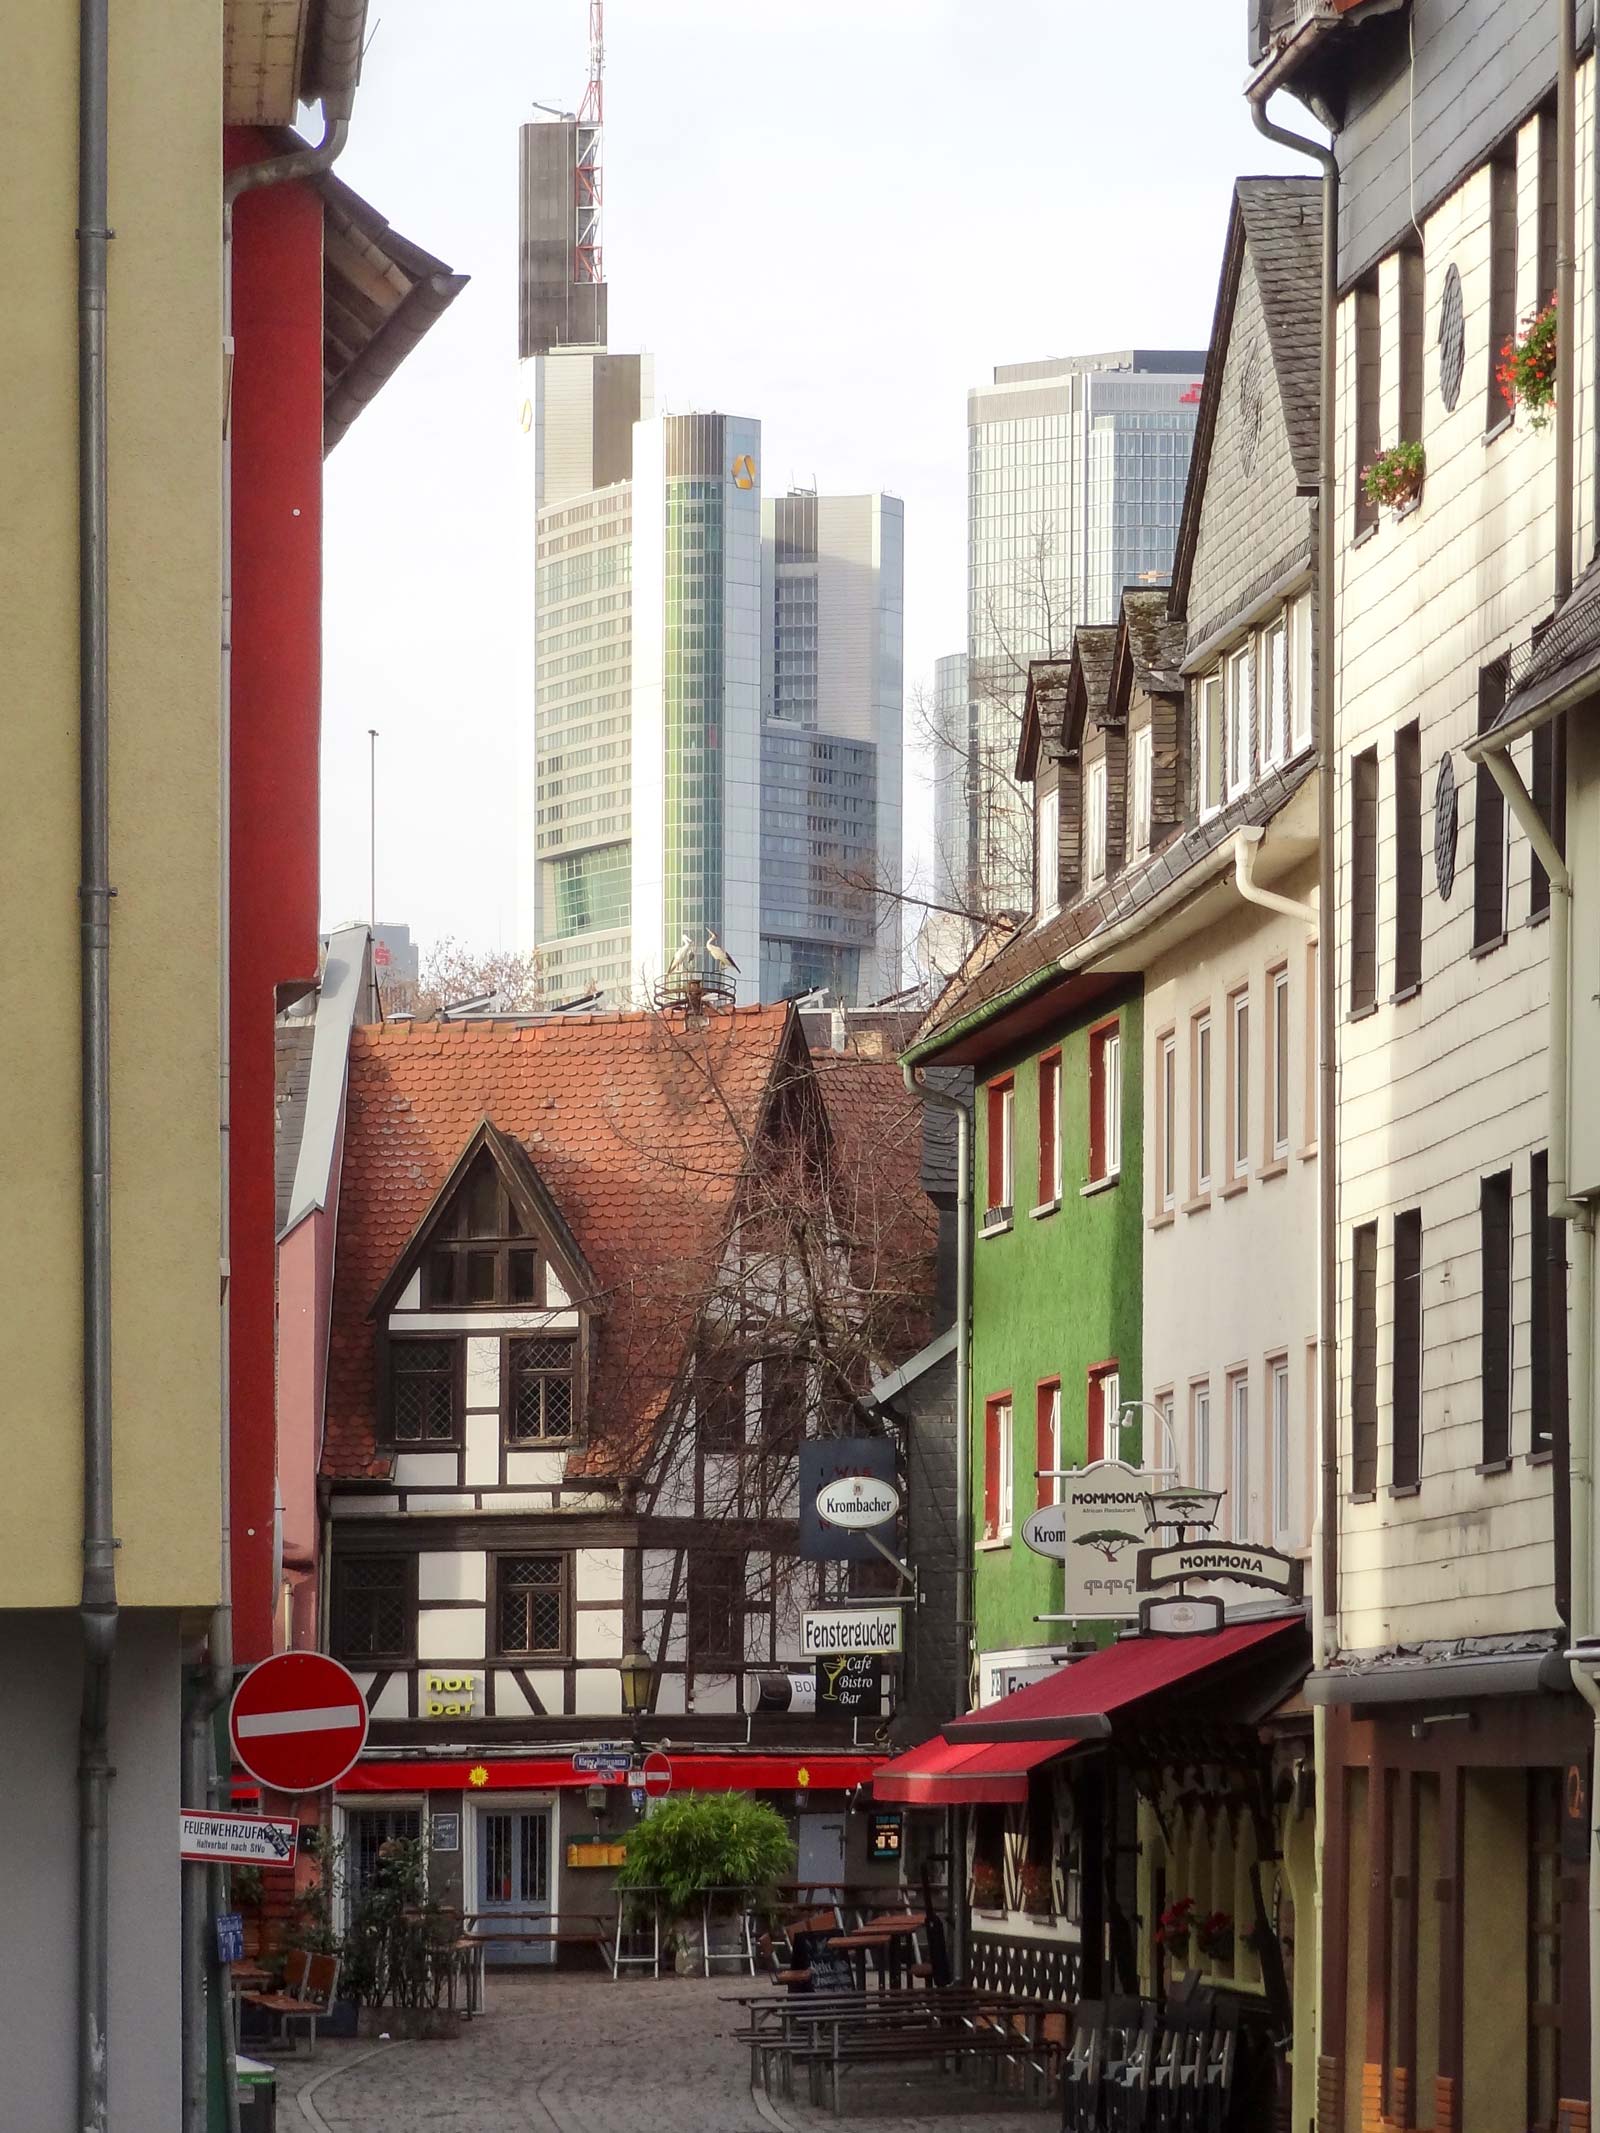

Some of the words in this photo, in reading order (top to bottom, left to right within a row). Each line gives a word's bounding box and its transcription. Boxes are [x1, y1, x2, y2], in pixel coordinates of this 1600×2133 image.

[826, 1496, 892, 1513] Krombacher
[1071, 1492, 1145, 1505] MOMMONA
[1104, 1506, 1136, 1514] Restaurant
[1180, 1554, 1263, 1573] MOMMONA
[806, 1616, 897, 1648] Fenstergucker
[846, 1655, 873, 1674] Café
[426, 1672, 475, 1692] hot
[838, 1675, 873, 1688] Bistro
[427, 1696, 476, 1716] bar
[838, 1691, 862, 1704] Bar
[230, 1842, 248, 1852] nach
